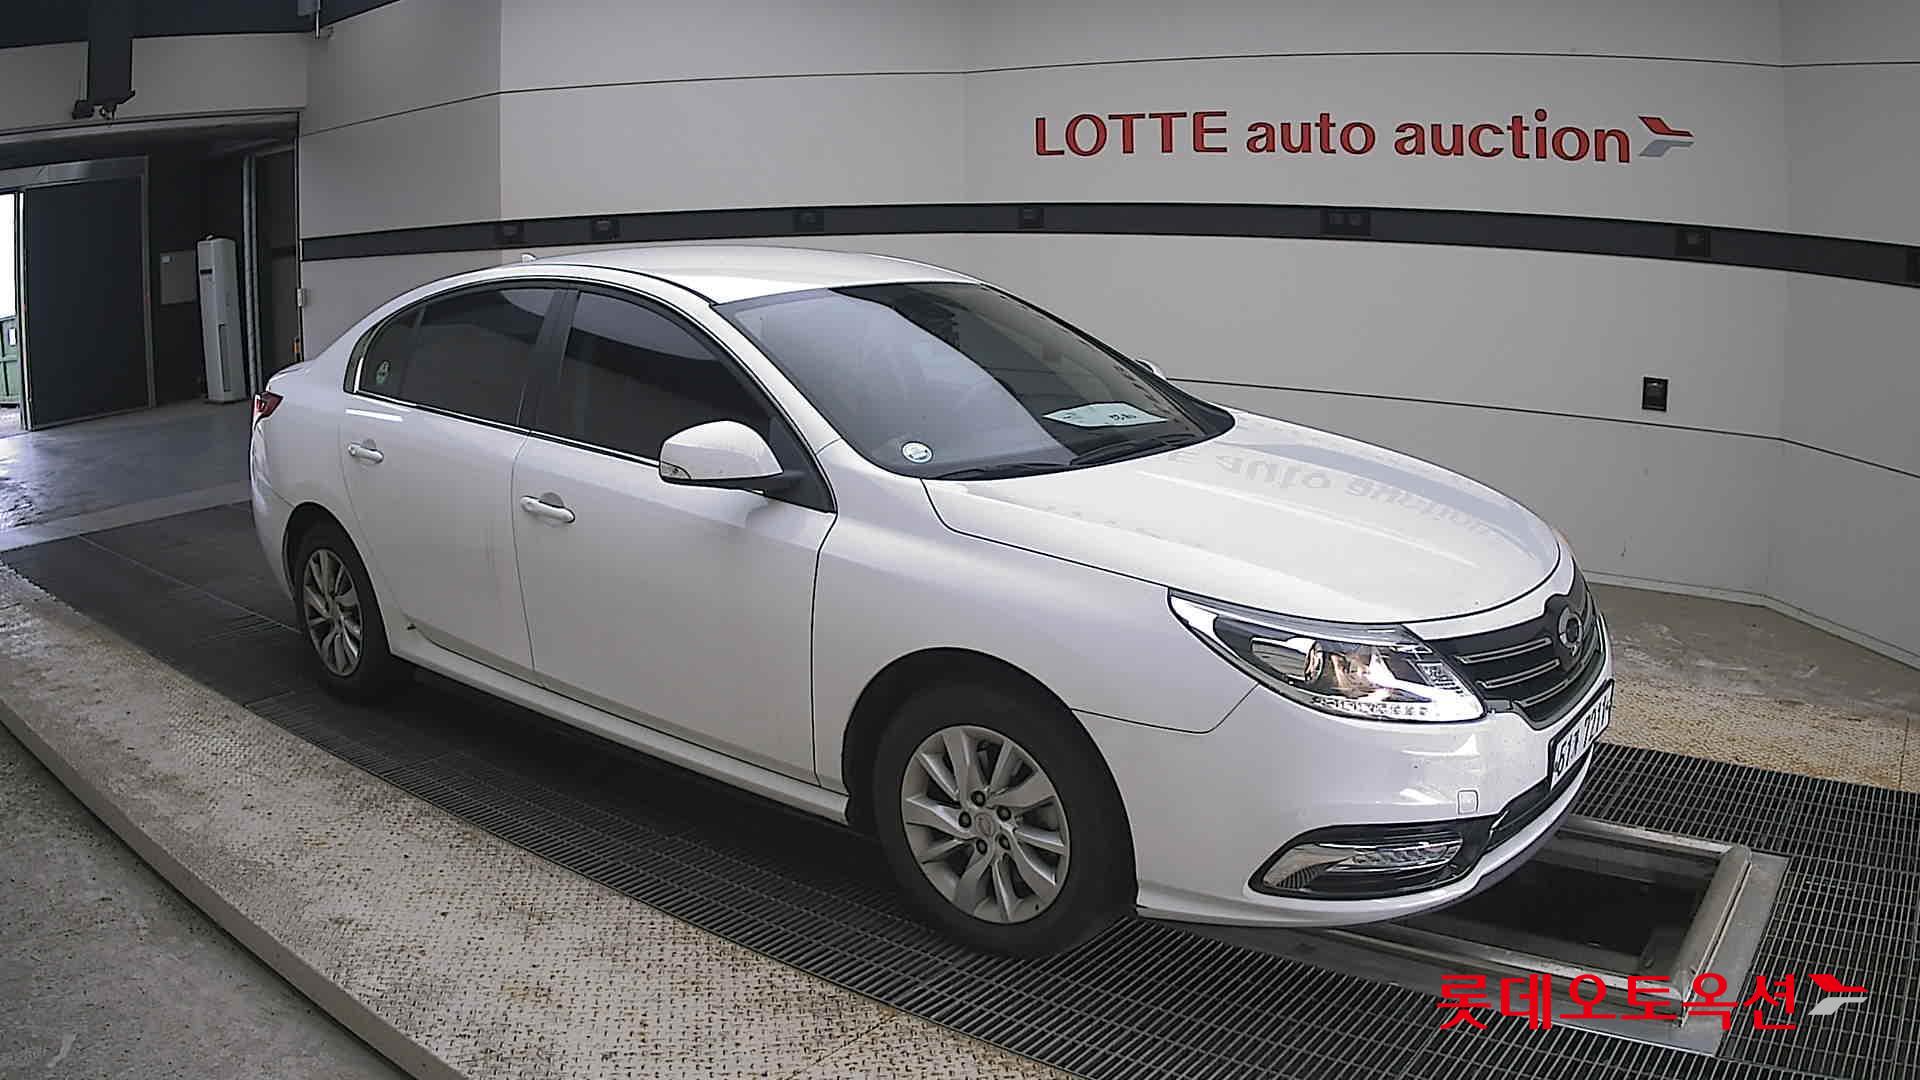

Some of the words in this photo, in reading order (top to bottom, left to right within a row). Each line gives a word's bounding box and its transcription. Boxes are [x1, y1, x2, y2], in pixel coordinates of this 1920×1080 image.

[1035, 111, 1226, 156] LOTTE
[1246, 112, 1376, 155] auto
[1394, 109, 1631, 163] auction
